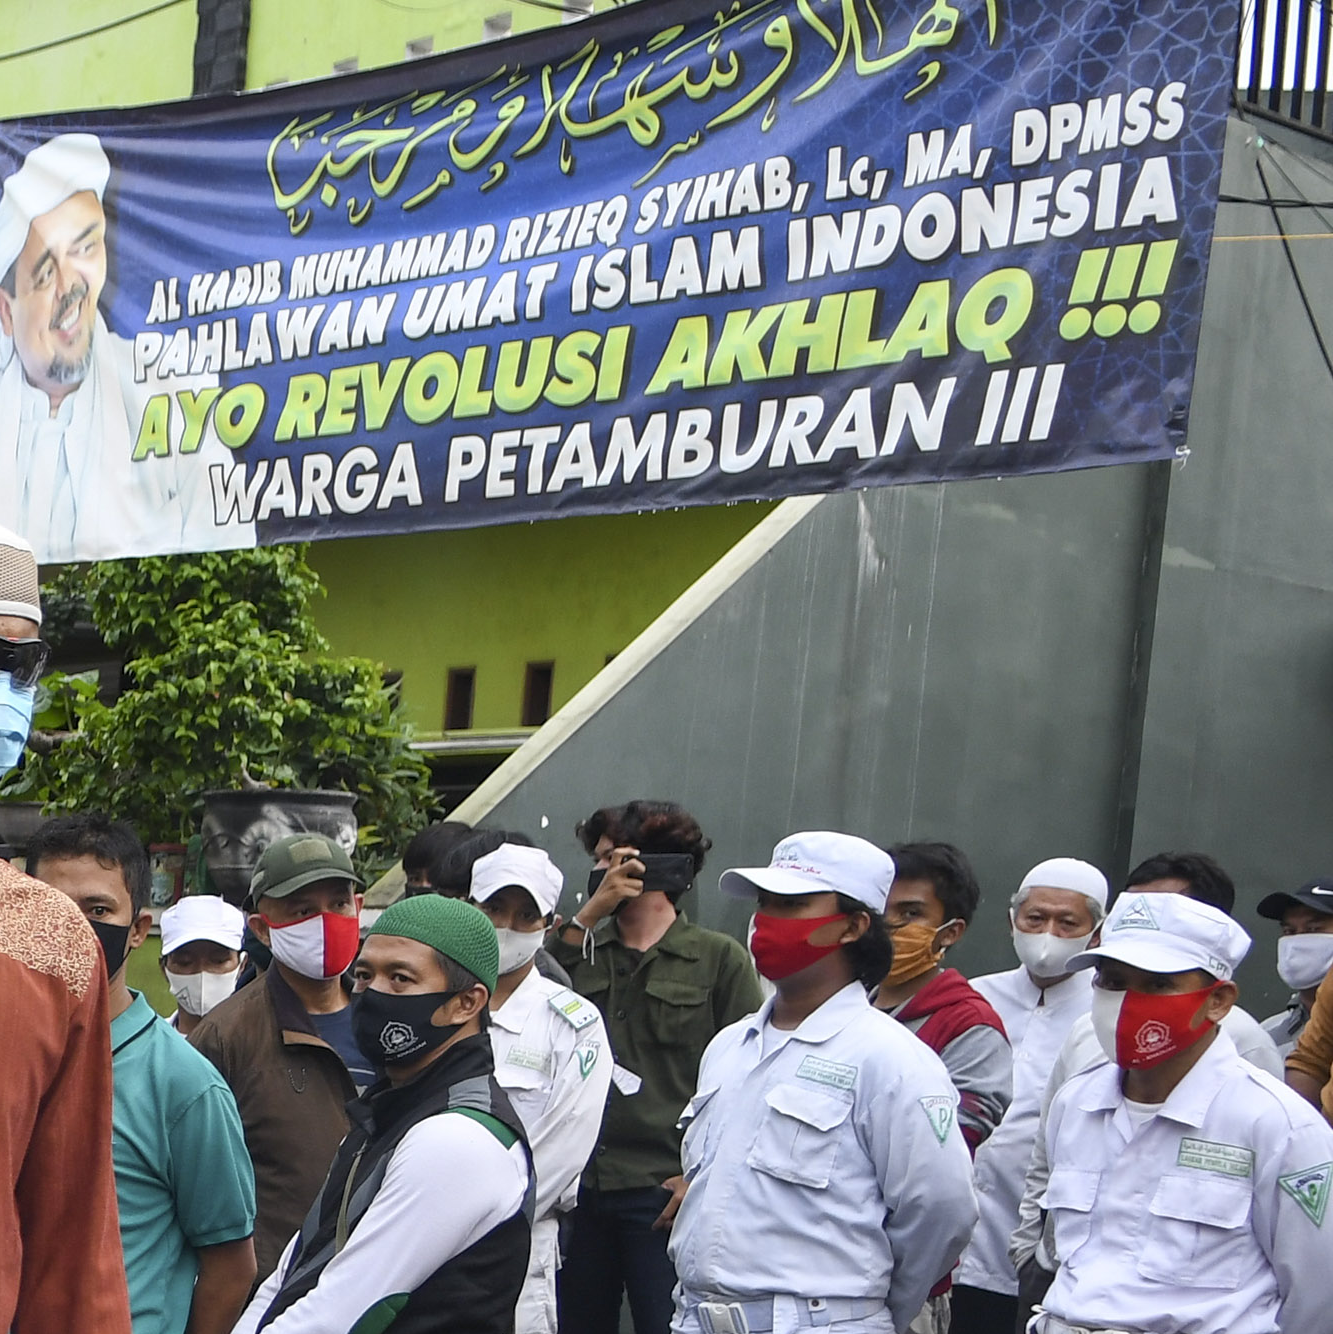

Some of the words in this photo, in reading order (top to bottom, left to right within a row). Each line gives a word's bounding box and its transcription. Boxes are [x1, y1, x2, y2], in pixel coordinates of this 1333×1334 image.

[133, 299, 388, 383] PAHLAWAN
[402, 262, 558, 341] UMAT
[571, 225, 761, 313] ISLAM
[787, 156, 1178, 283] INDONESIA
[146, 280, 183, 324] AL
[188, 257, 281, 310] HABIB
[289, 223, 495, 301] MUHAMMAD
[499, 194, 629, 264] RIZIEQ
[634, 155, 810, 232] SYIHAB,
[825, 146, 889, 201] Lc,
[903, 124, 992, 188] MA,
[1011, 82, 1187, 167] DPMSS
[131, 382, 267, 461] AYO
[274, 325, 633, 444] REVOLUSI
[644, 266, 1035, 396] AKHLAQ
[208, 443, 423, 525] WARGA
[444, 377, 958, 502] PETAMBURAN
[974, 362, 1067, 447] III
